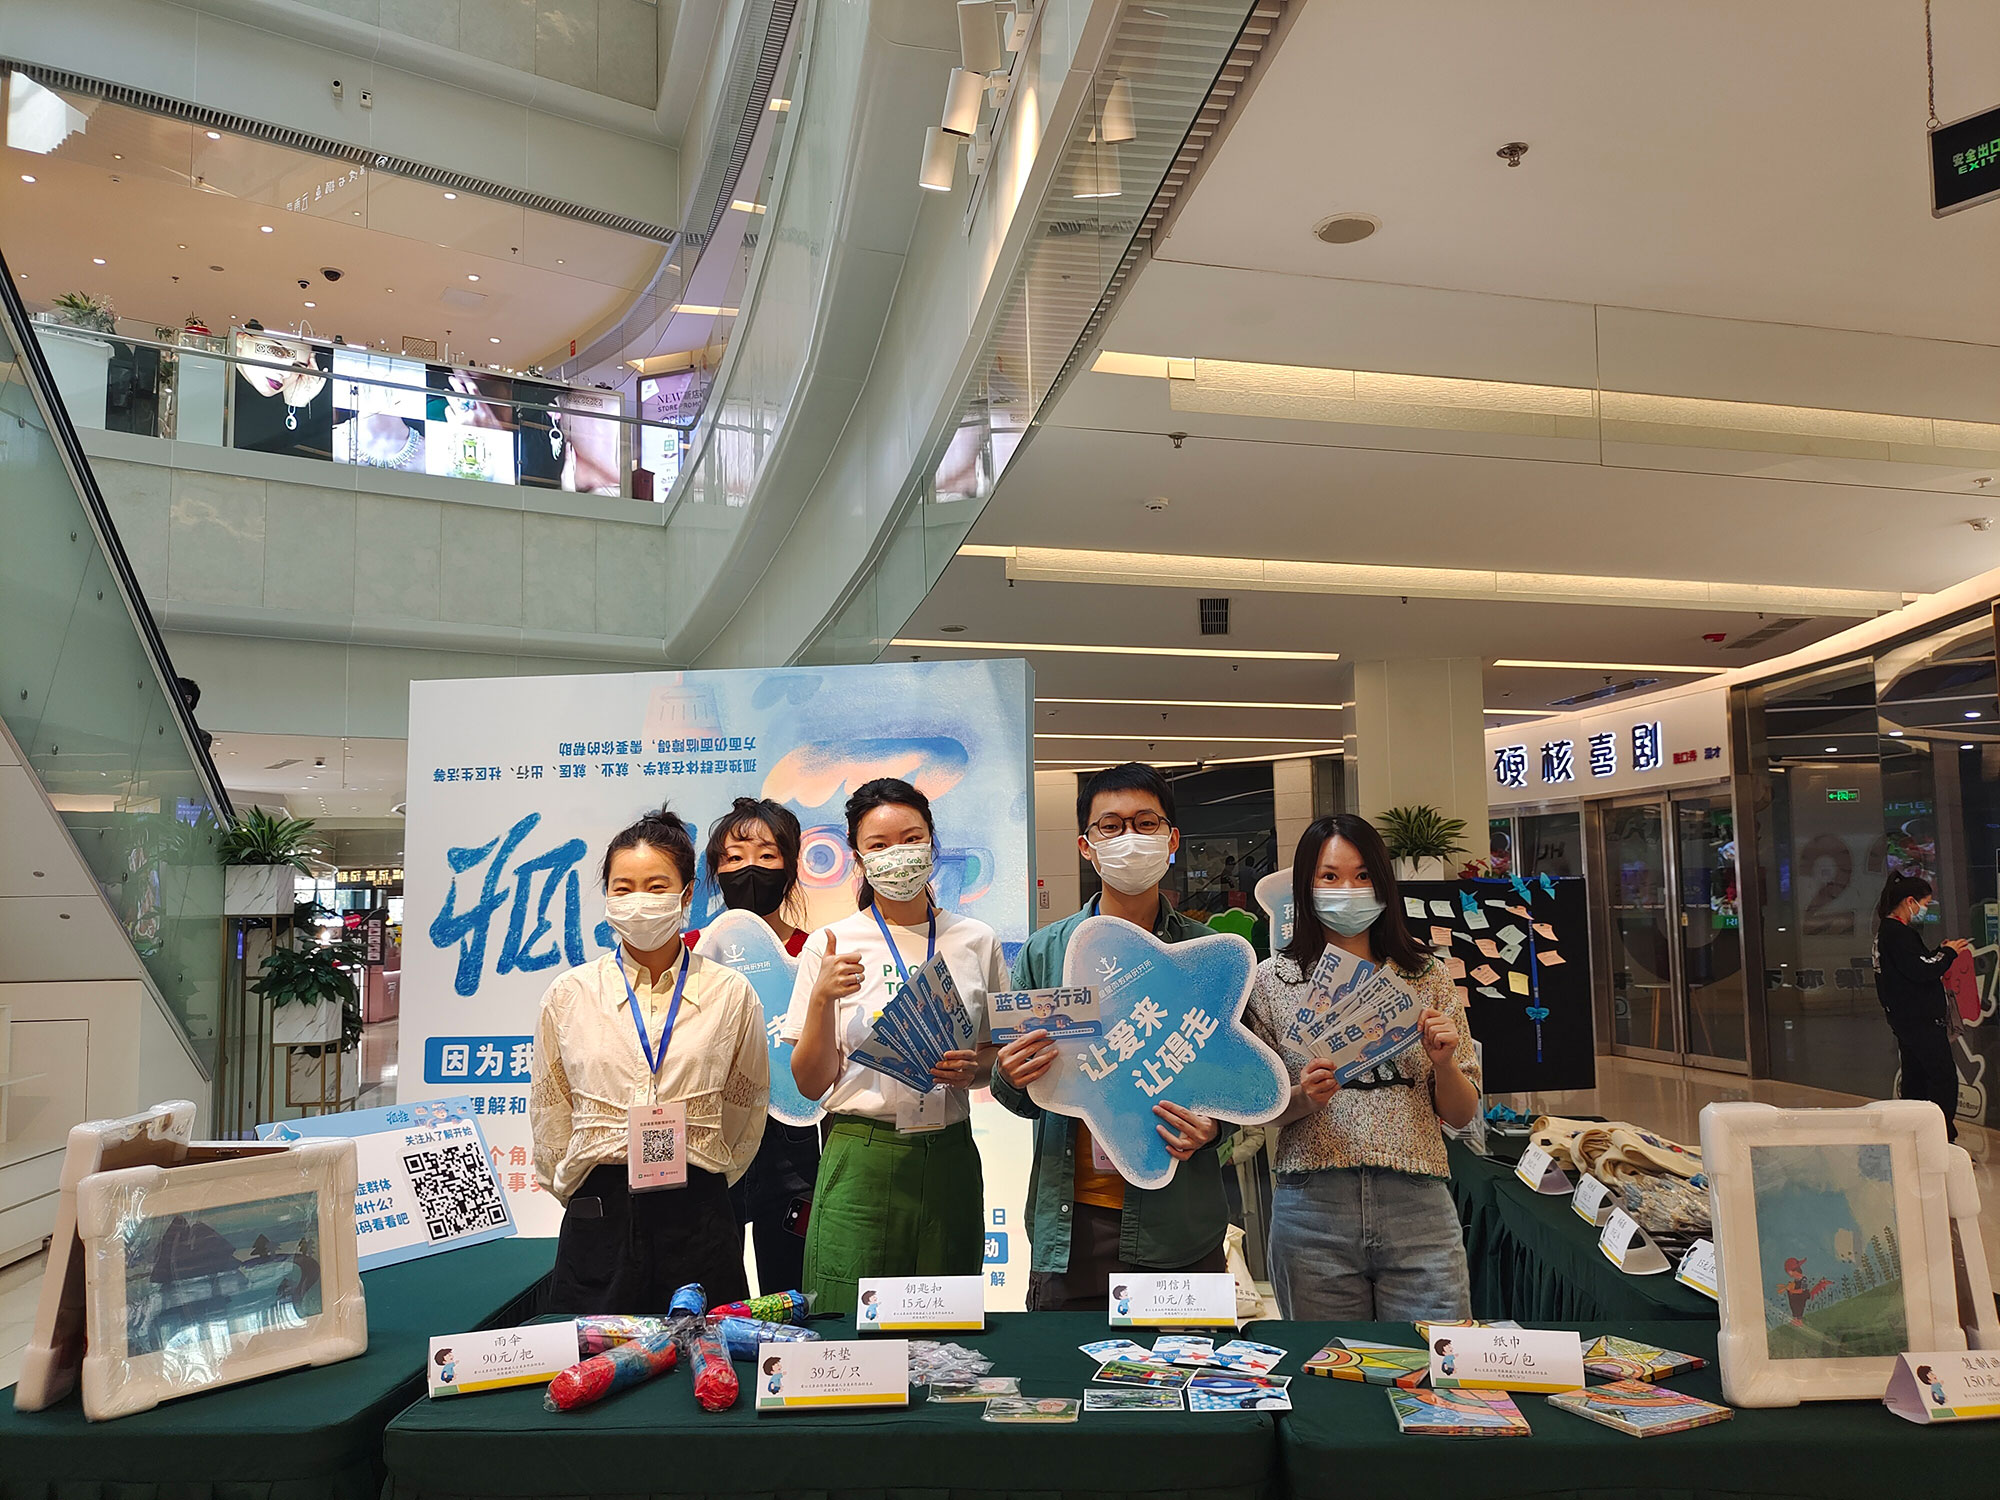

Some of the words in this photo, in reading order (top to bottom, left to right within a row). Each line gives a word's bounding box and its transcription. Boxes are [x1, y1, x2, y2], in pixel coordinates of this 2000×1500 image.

[1952, 138, 2000, 167] 安全出口
[1958, 154, 1997, 175] EXIT
[658, 392, 681, 403] NEW
[657, 404, 678, 412] STORE
[1493, 721, 1663, 788] 硬核喜剧
[894, 870, 909, 878] Grab
[1077, 996, 1168, 1082] 让爱来
[1131, 1007, 1219, 1097] 让碍走
[405, 1126, 473, 1146] 关注从了解开始
[489, 1146, 536, 1166] 个角
[905, 1282, 942, 1294] 钥匙扣
[1156, 1279, 1191, 1290] 明信片
[902, 1297, 945, 1309] 15元/枚
[1153, 1294, 1197, 1305] 10元/套
[494, 1333, 522, 1346] 雨伞
[1493, 1335, 1520, 1348] 纸巾
[482, 1348, 534, 1365] 90元/把
[822, 1347, 851, 1361] 杯垫
[1483, 1352, 1535, 1367] 10元/包
[810, 1365, 861, 1379] 39元/只
